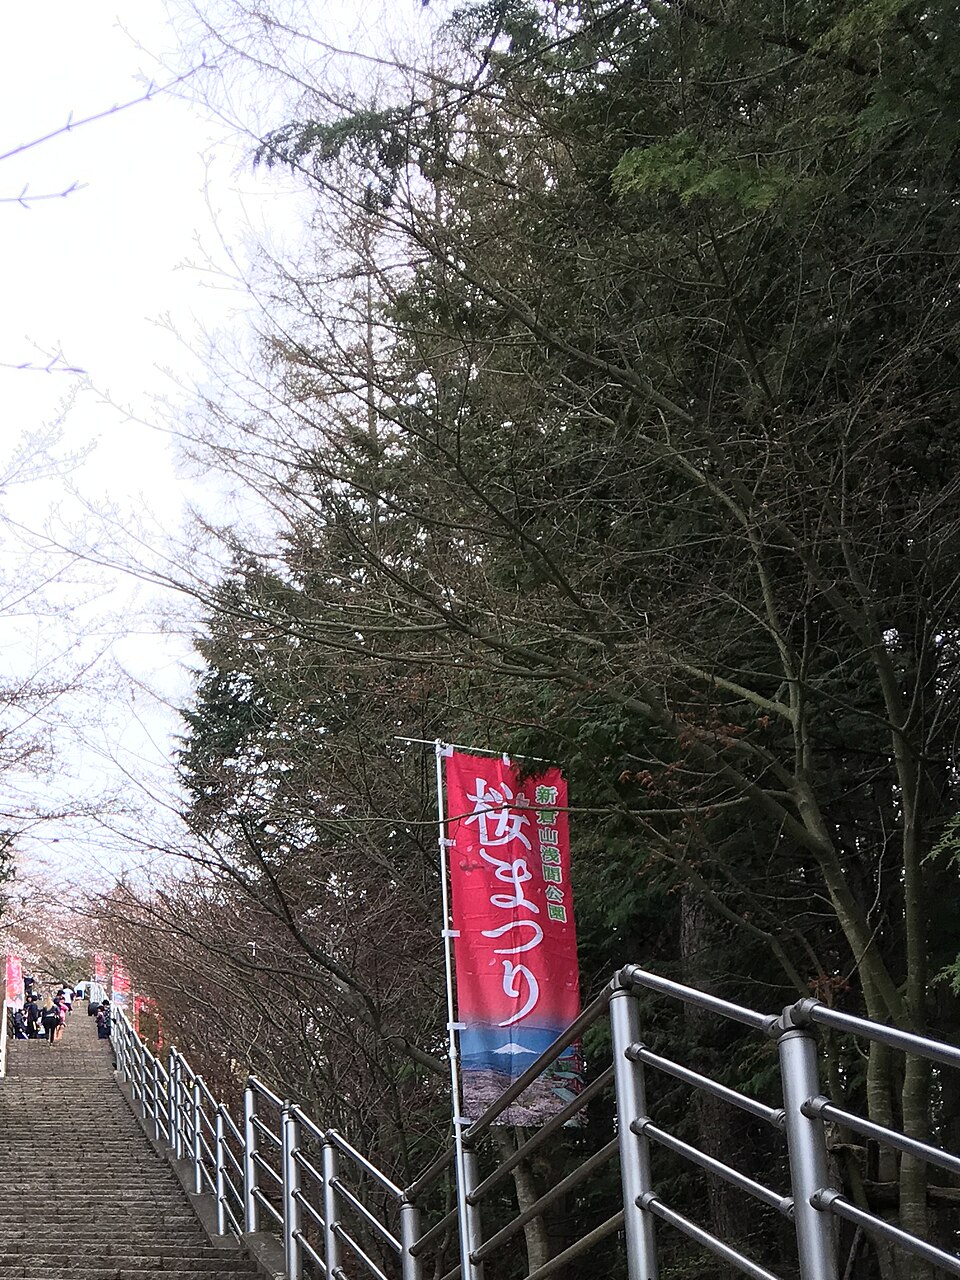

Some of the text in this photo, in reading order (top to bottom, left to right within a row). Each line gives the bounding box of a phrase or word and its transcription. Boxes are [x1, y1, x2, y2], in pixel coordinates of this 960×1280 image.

[464, 777, 544, 1028] 桜まつり
[535, 784, 568, 924] 新倉山浅間公園
